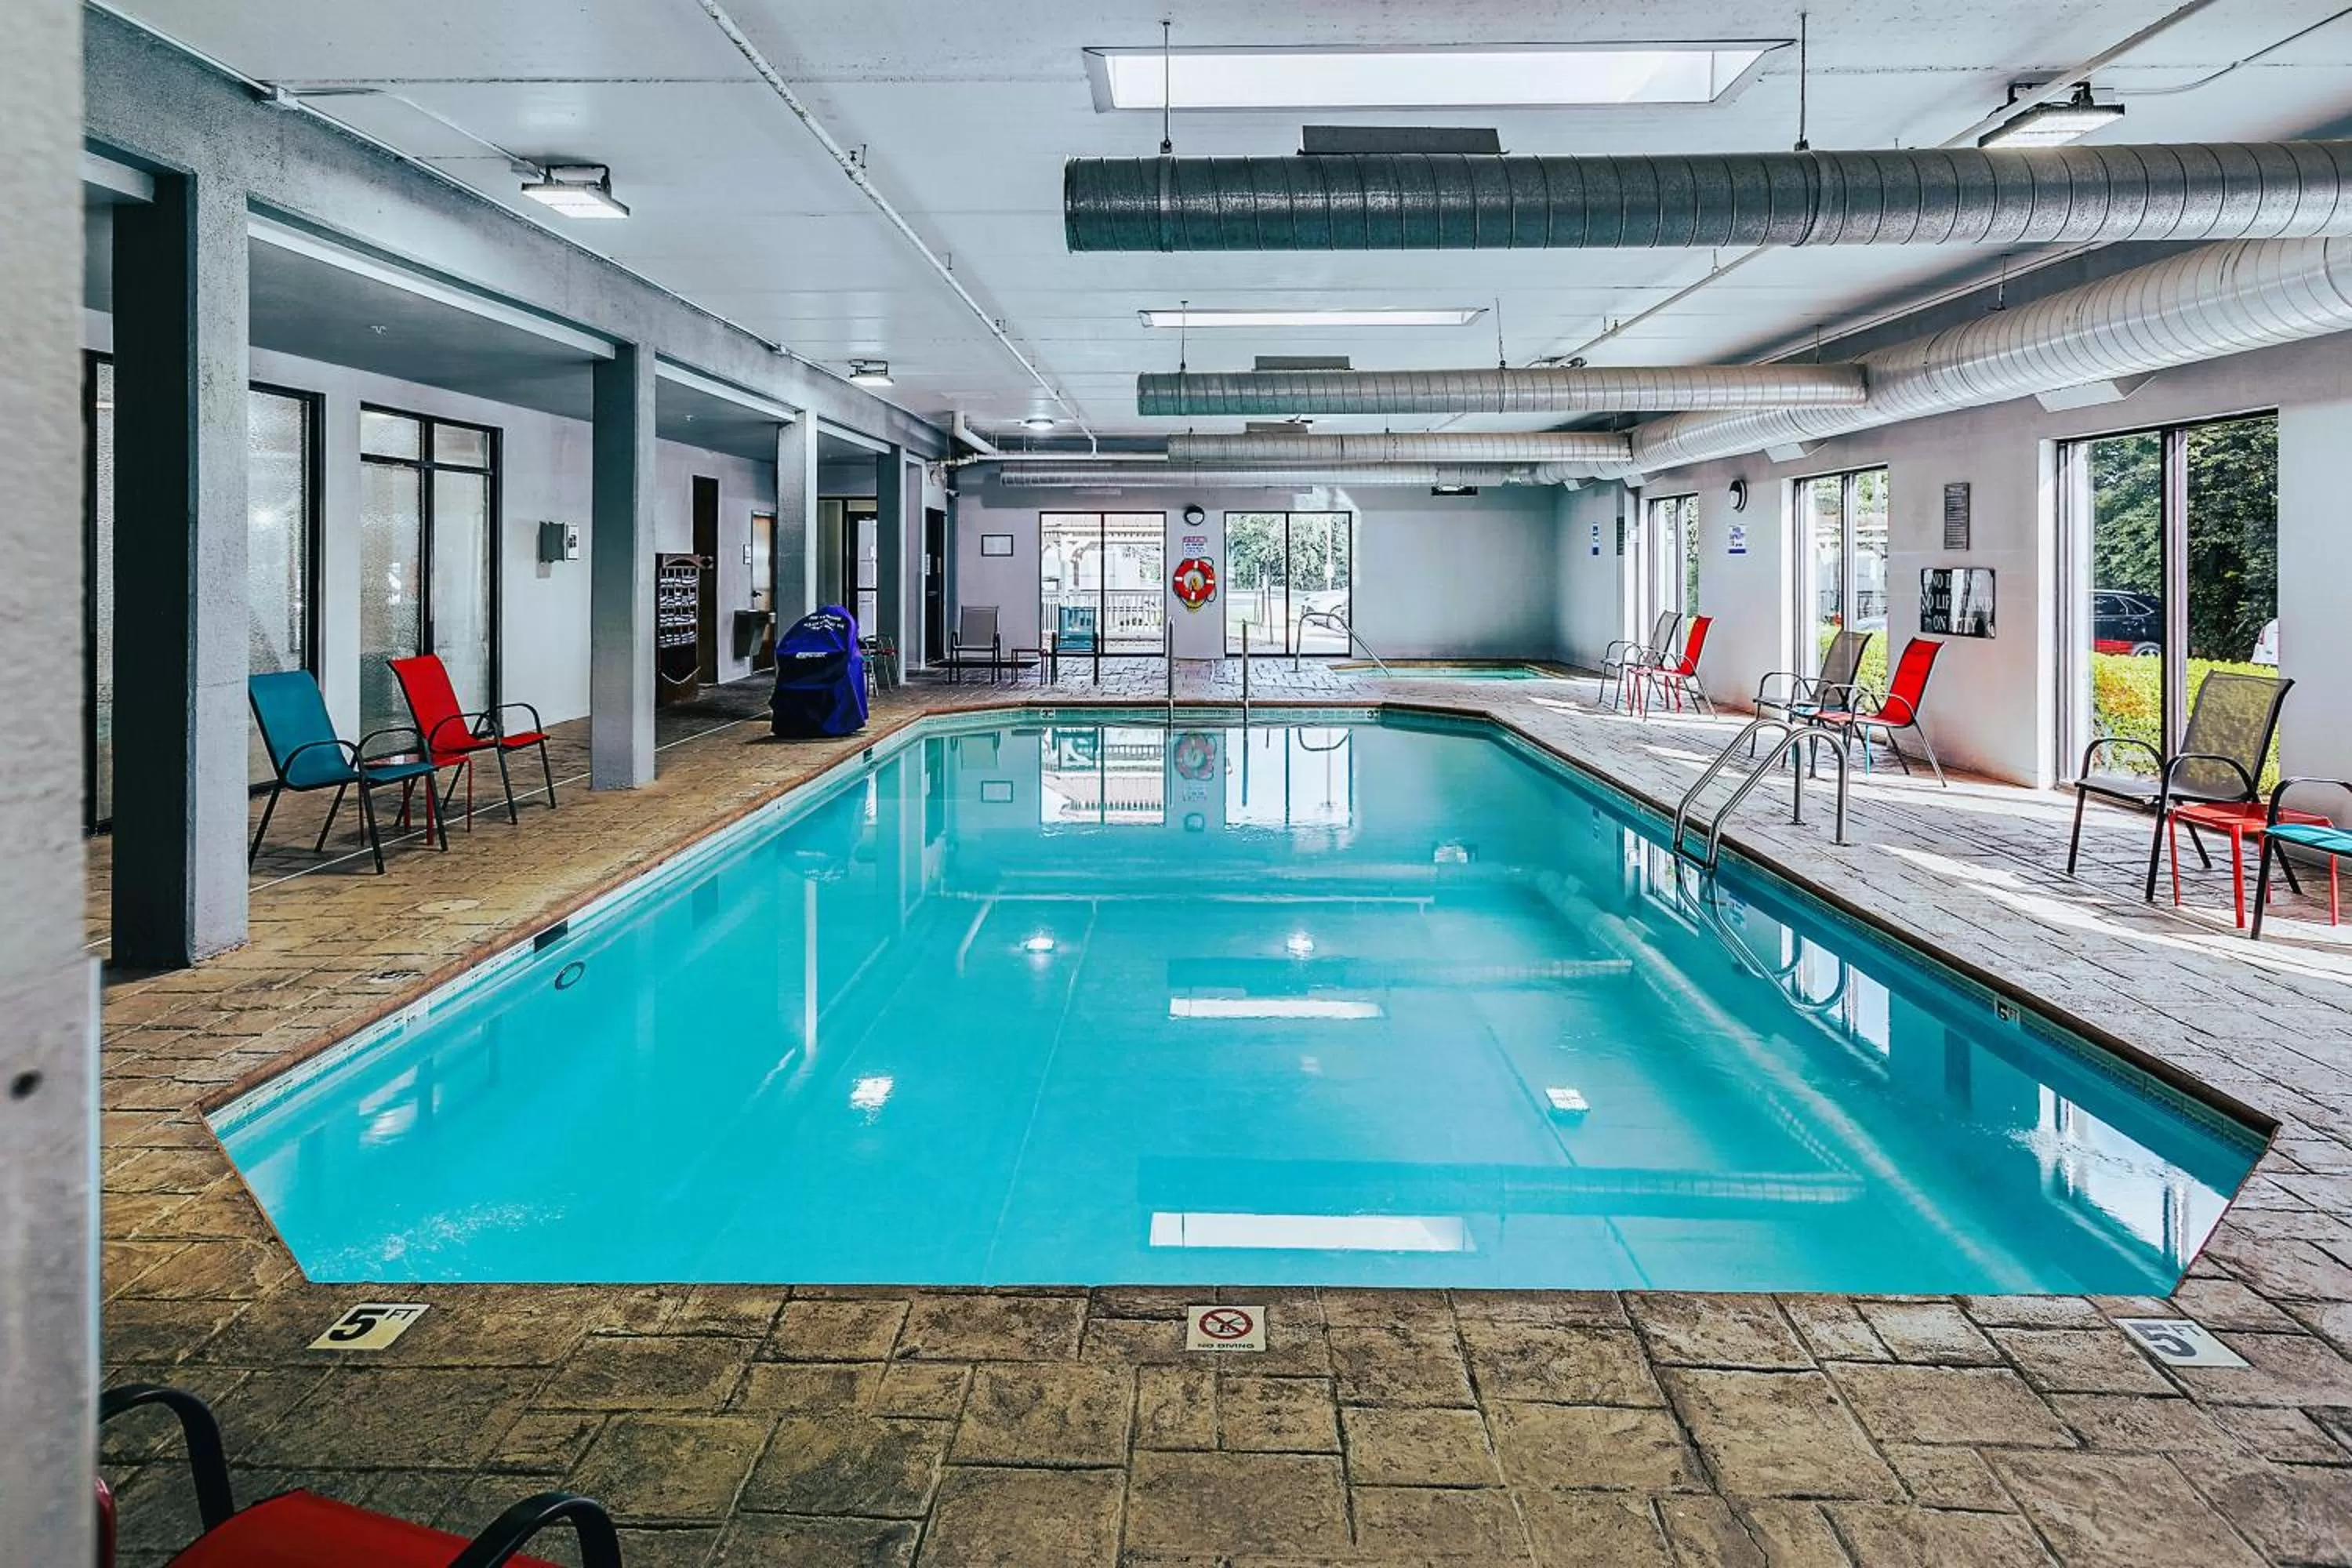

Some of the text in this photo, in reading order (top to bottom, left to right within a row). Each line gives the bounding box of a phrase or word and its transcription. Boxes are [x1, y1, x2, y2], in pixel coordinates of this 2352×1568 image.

[1933, 615, 1947, 631] ON
[328, 1308, 419, 1341] 5 FT
[2129, 1323, 2201, 1357] 5 FT
